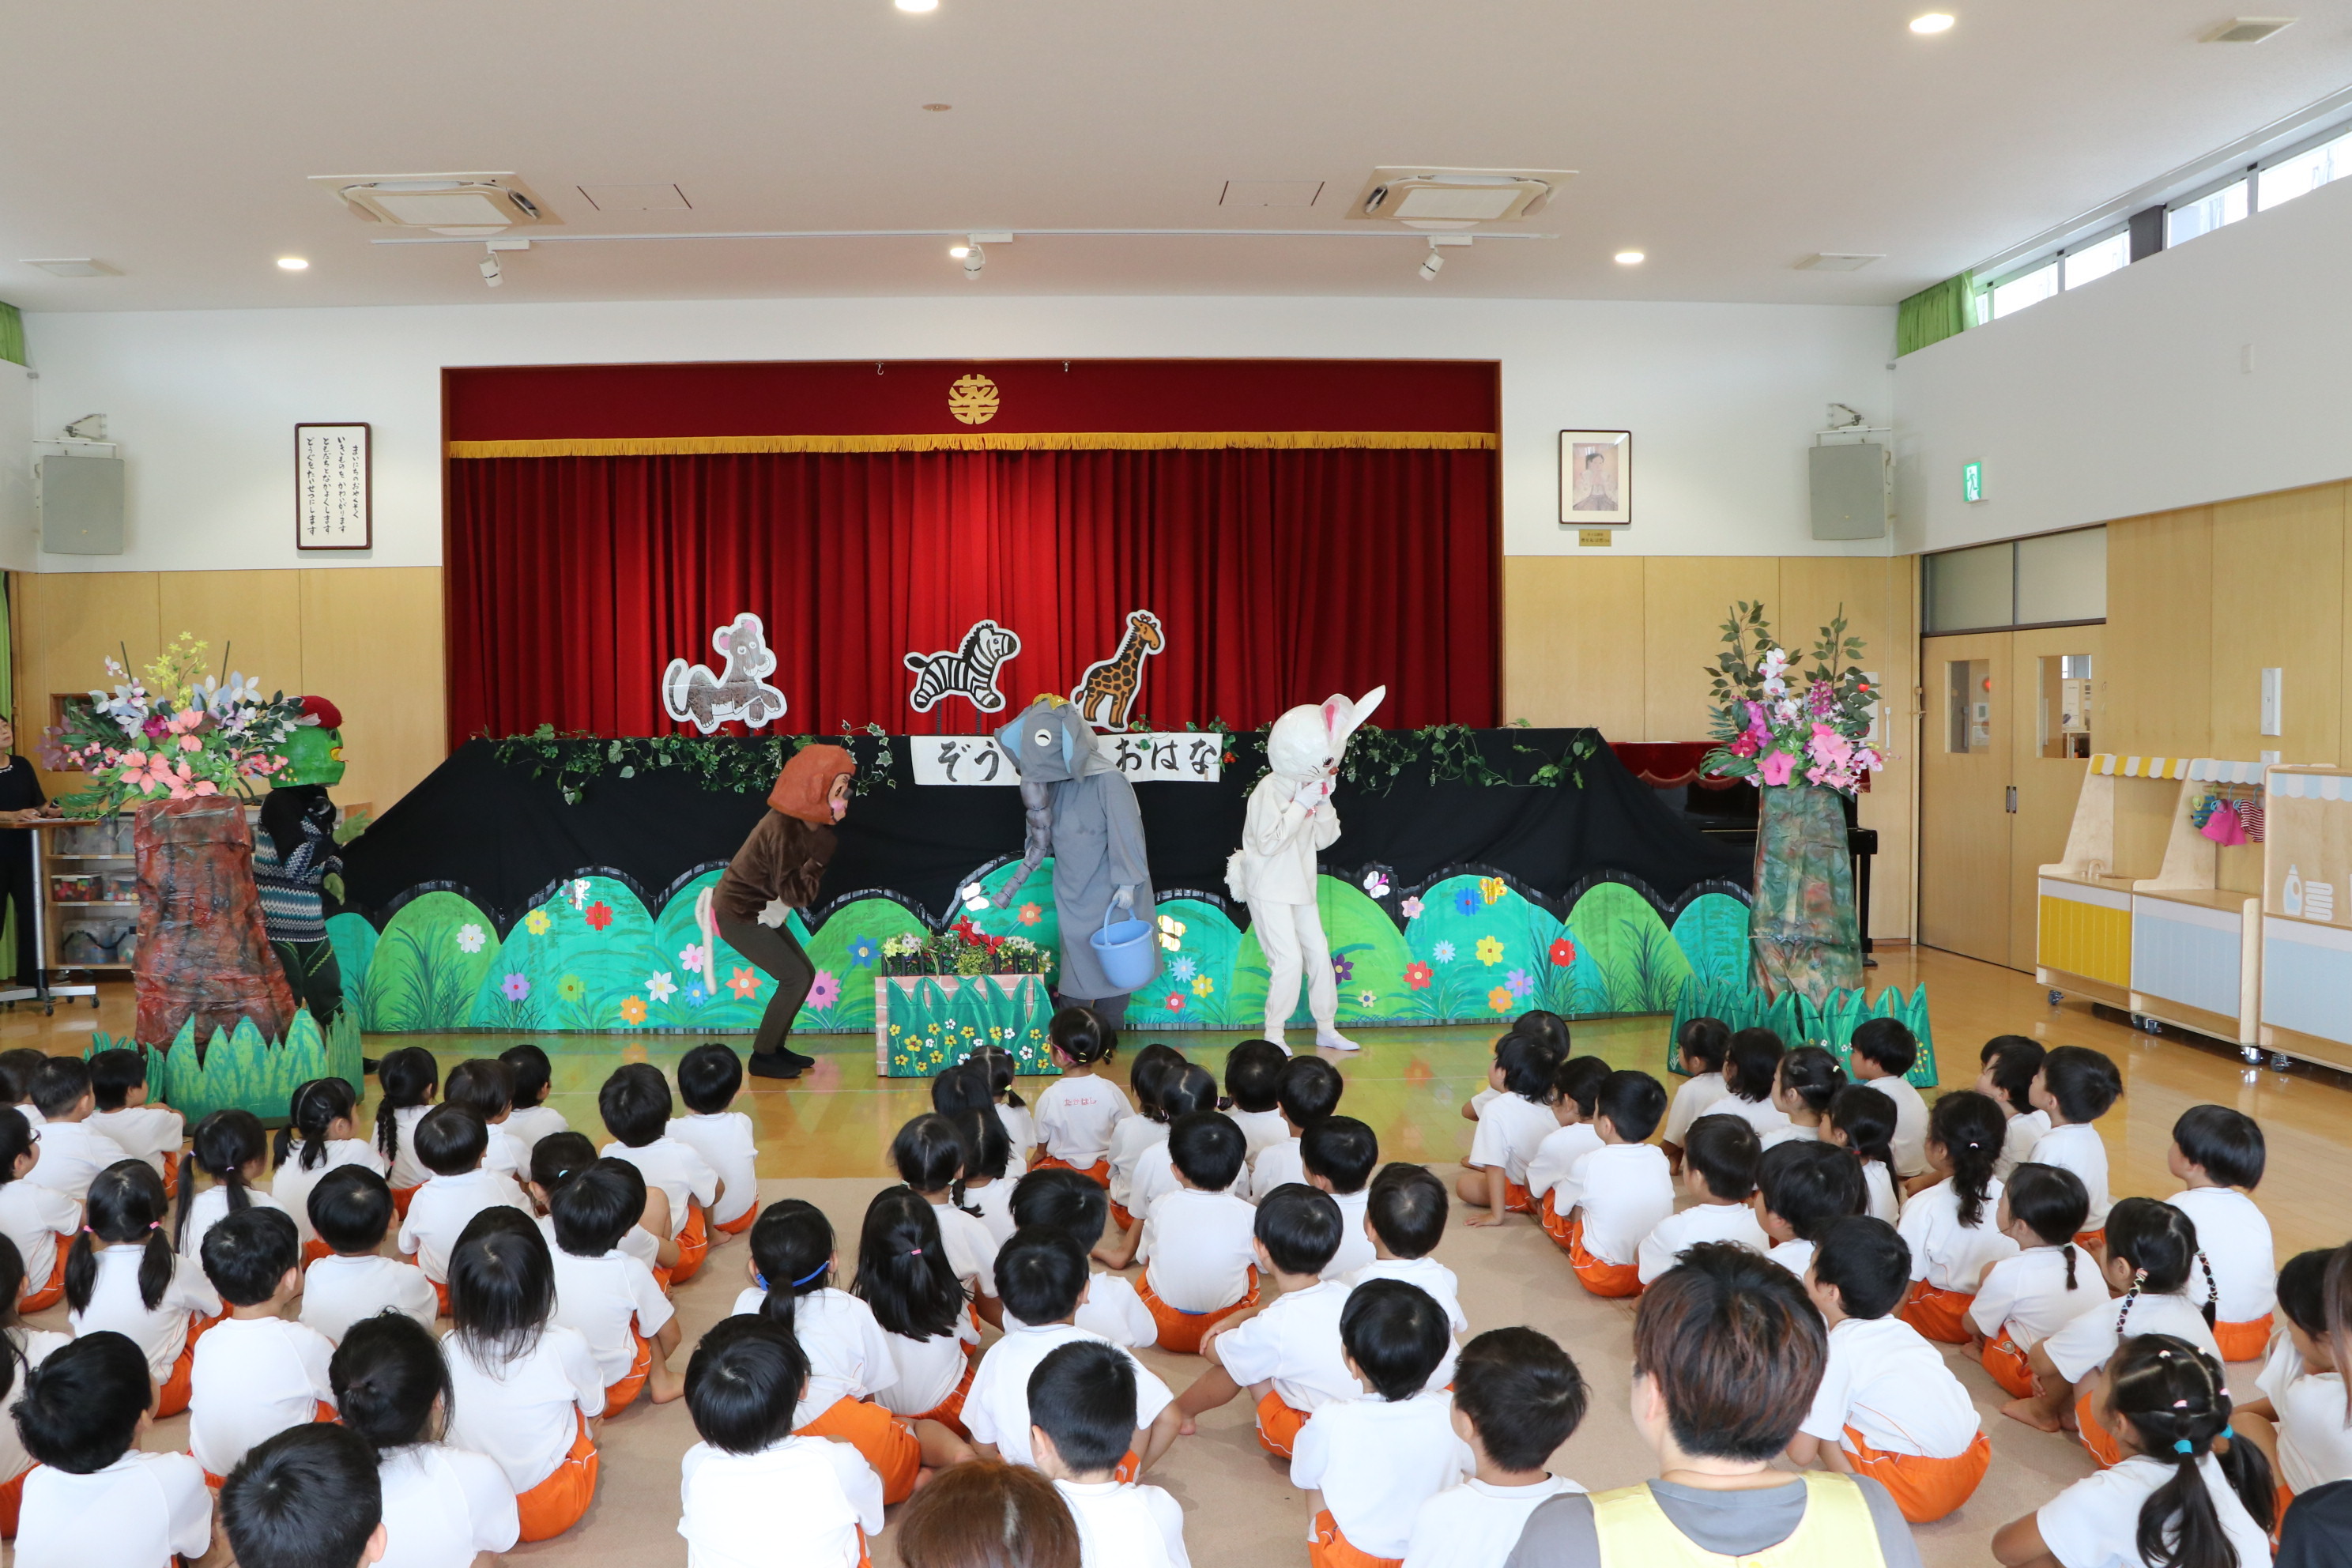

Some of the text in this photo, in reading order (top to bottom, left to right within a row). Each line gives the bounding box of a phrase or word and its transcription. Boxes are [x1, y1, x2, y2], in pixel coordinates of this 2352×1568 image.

[937, 737, 1218, 782] ぞう おはな
